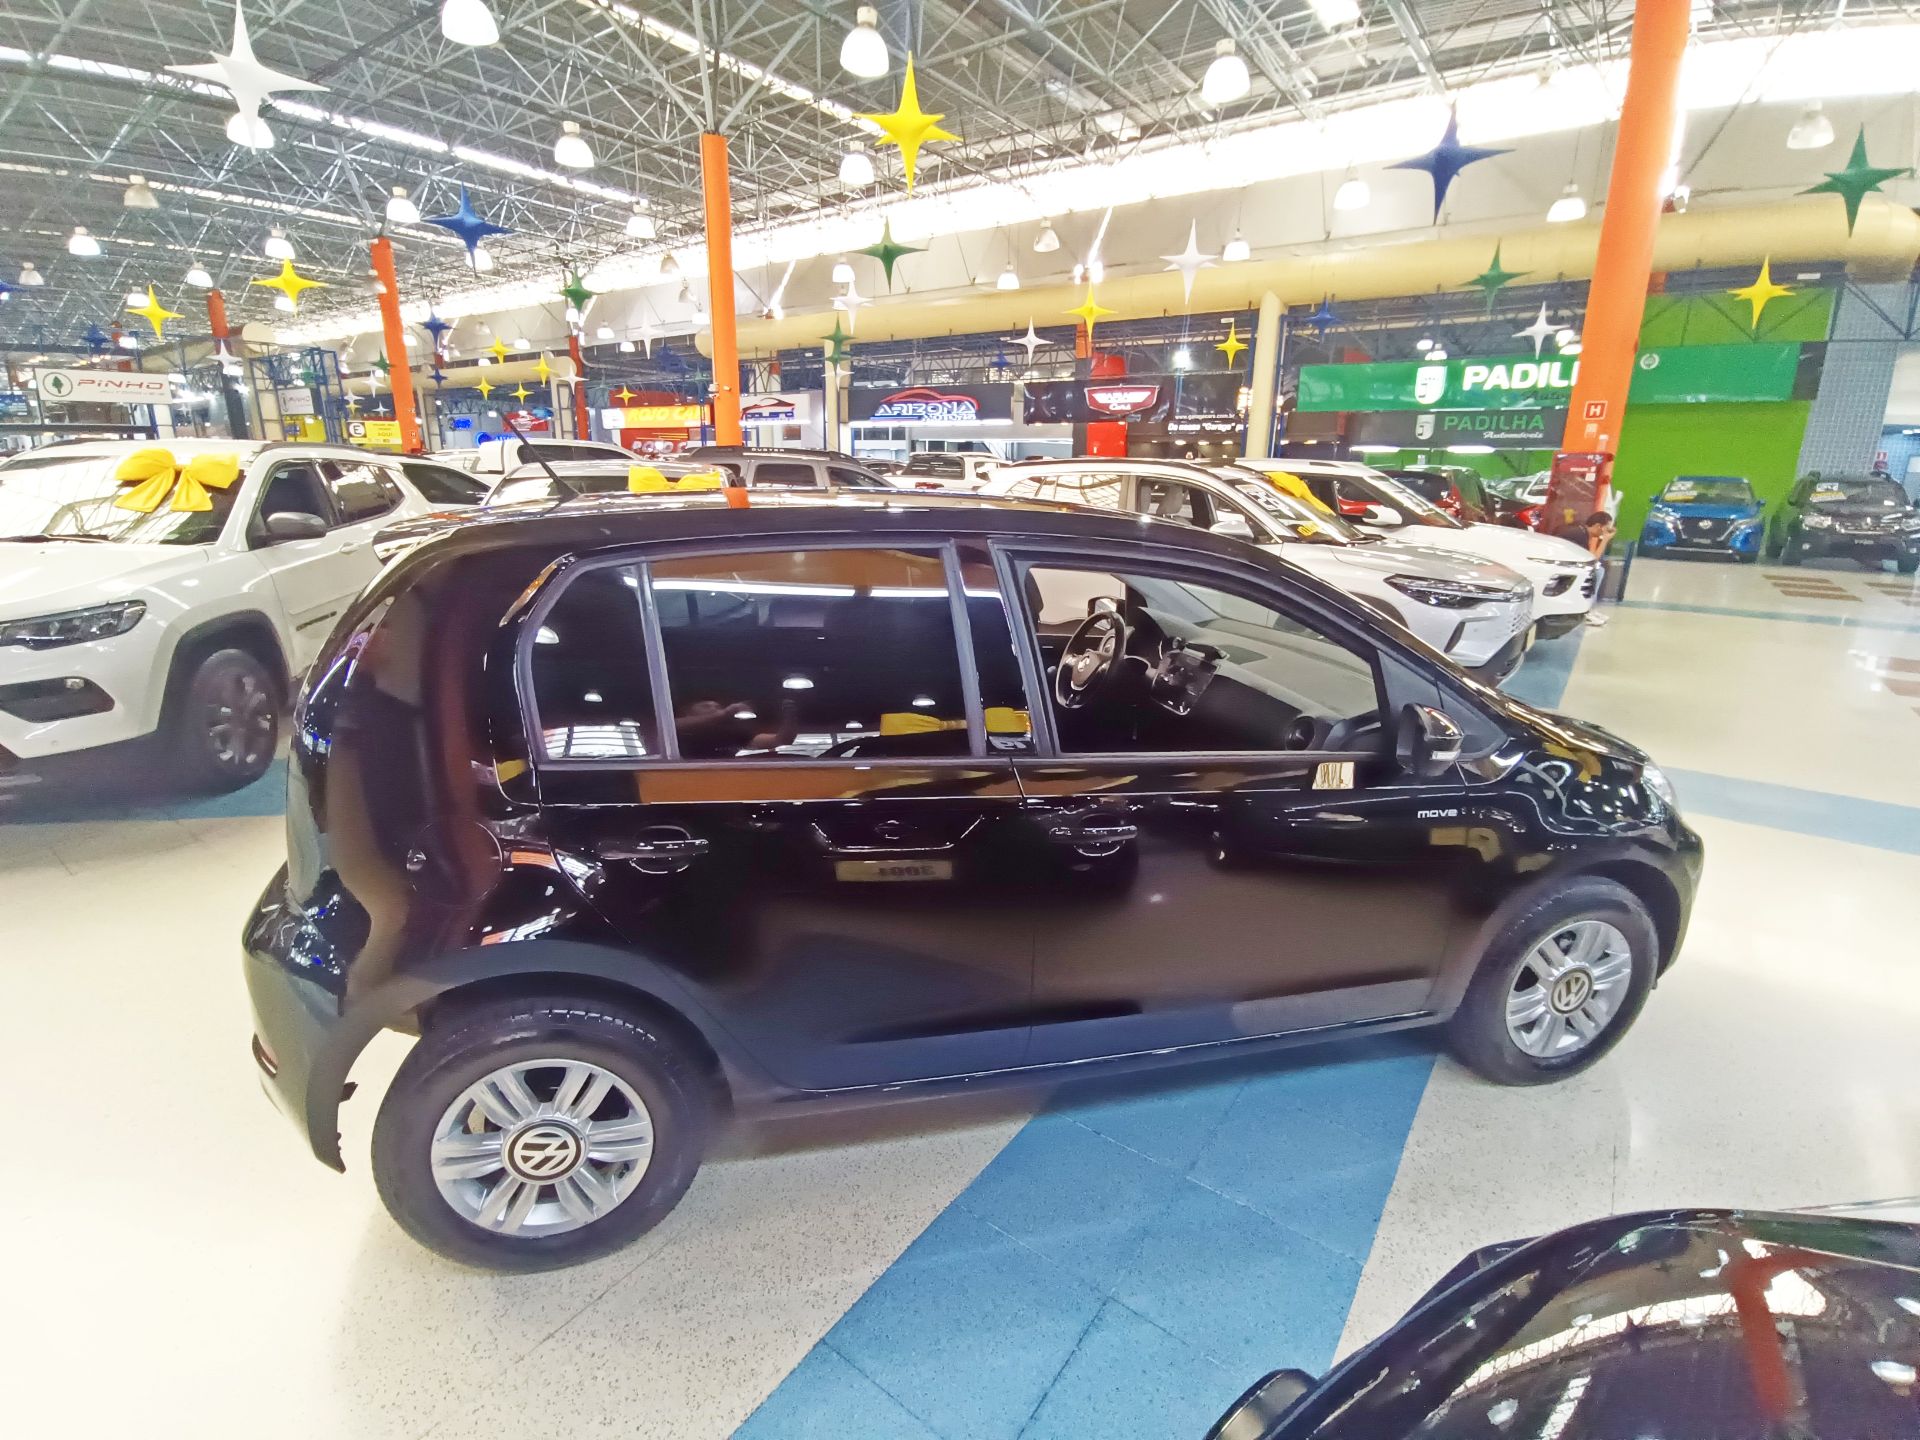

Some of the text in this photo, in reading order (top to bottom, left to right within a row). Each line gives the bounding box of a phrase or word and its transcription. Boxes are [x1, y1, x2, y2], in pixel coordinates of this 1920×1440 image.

[874, 401, 976, 416] ARIZONA
[1589, 405, 1601, 416] H
[1444, 415, 1545, 430] PADILHA
[353, 425, 362, 435] E
[1417, 809, 1458, 819] move
